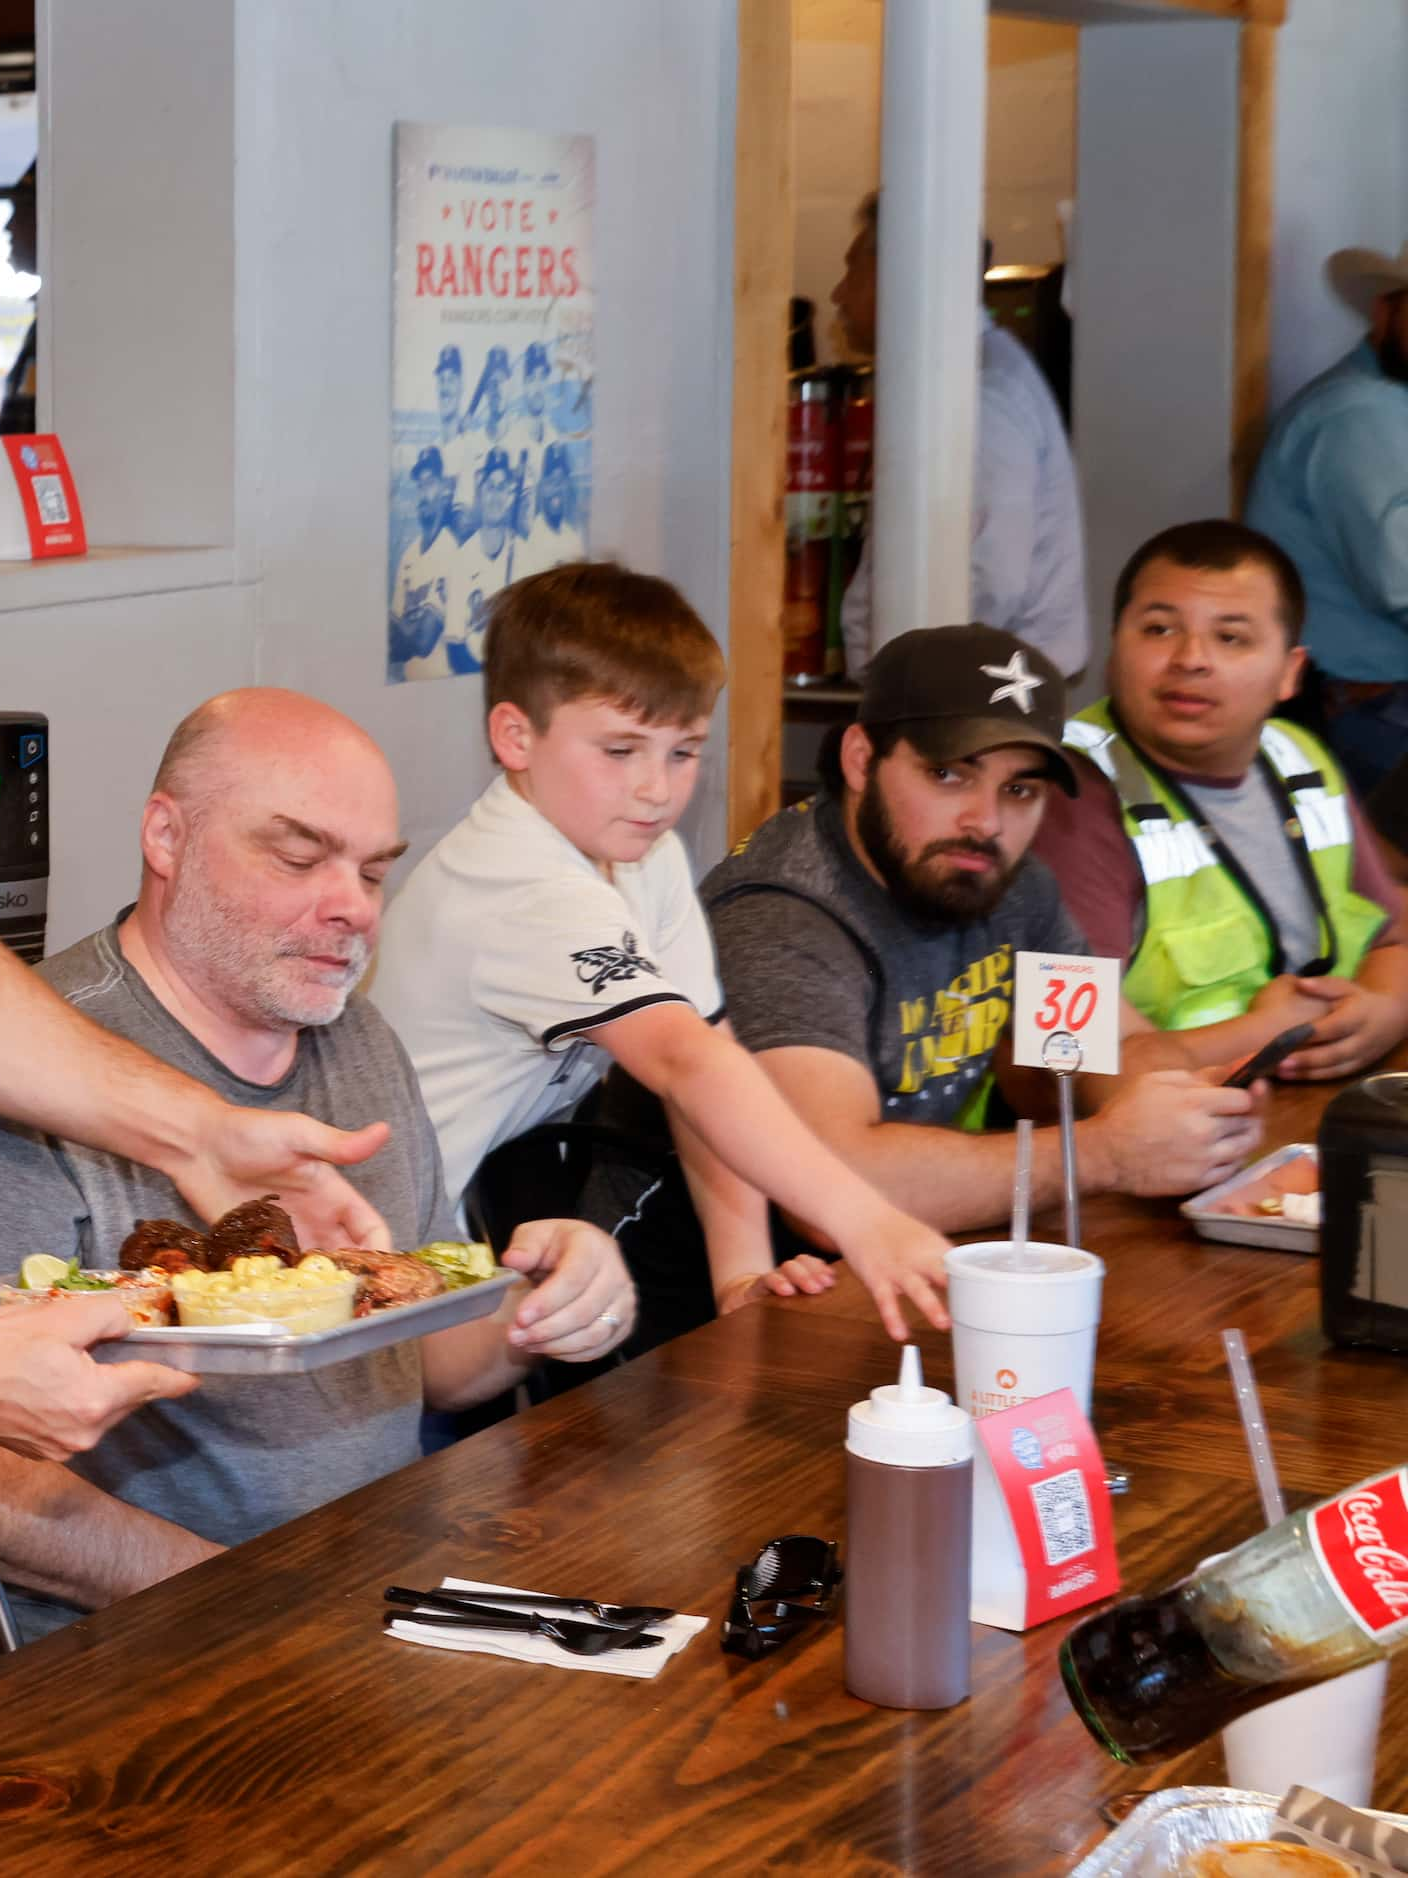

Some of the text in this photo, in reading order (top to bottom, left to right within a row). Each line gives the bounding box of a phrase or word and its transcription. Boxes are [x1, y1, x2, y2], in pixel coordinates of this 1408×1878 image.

[460, 197, 536, 233] VOTE
[415, 242, 581, 299] RANGERS
[1034, 977, 1099, 1032] 30
